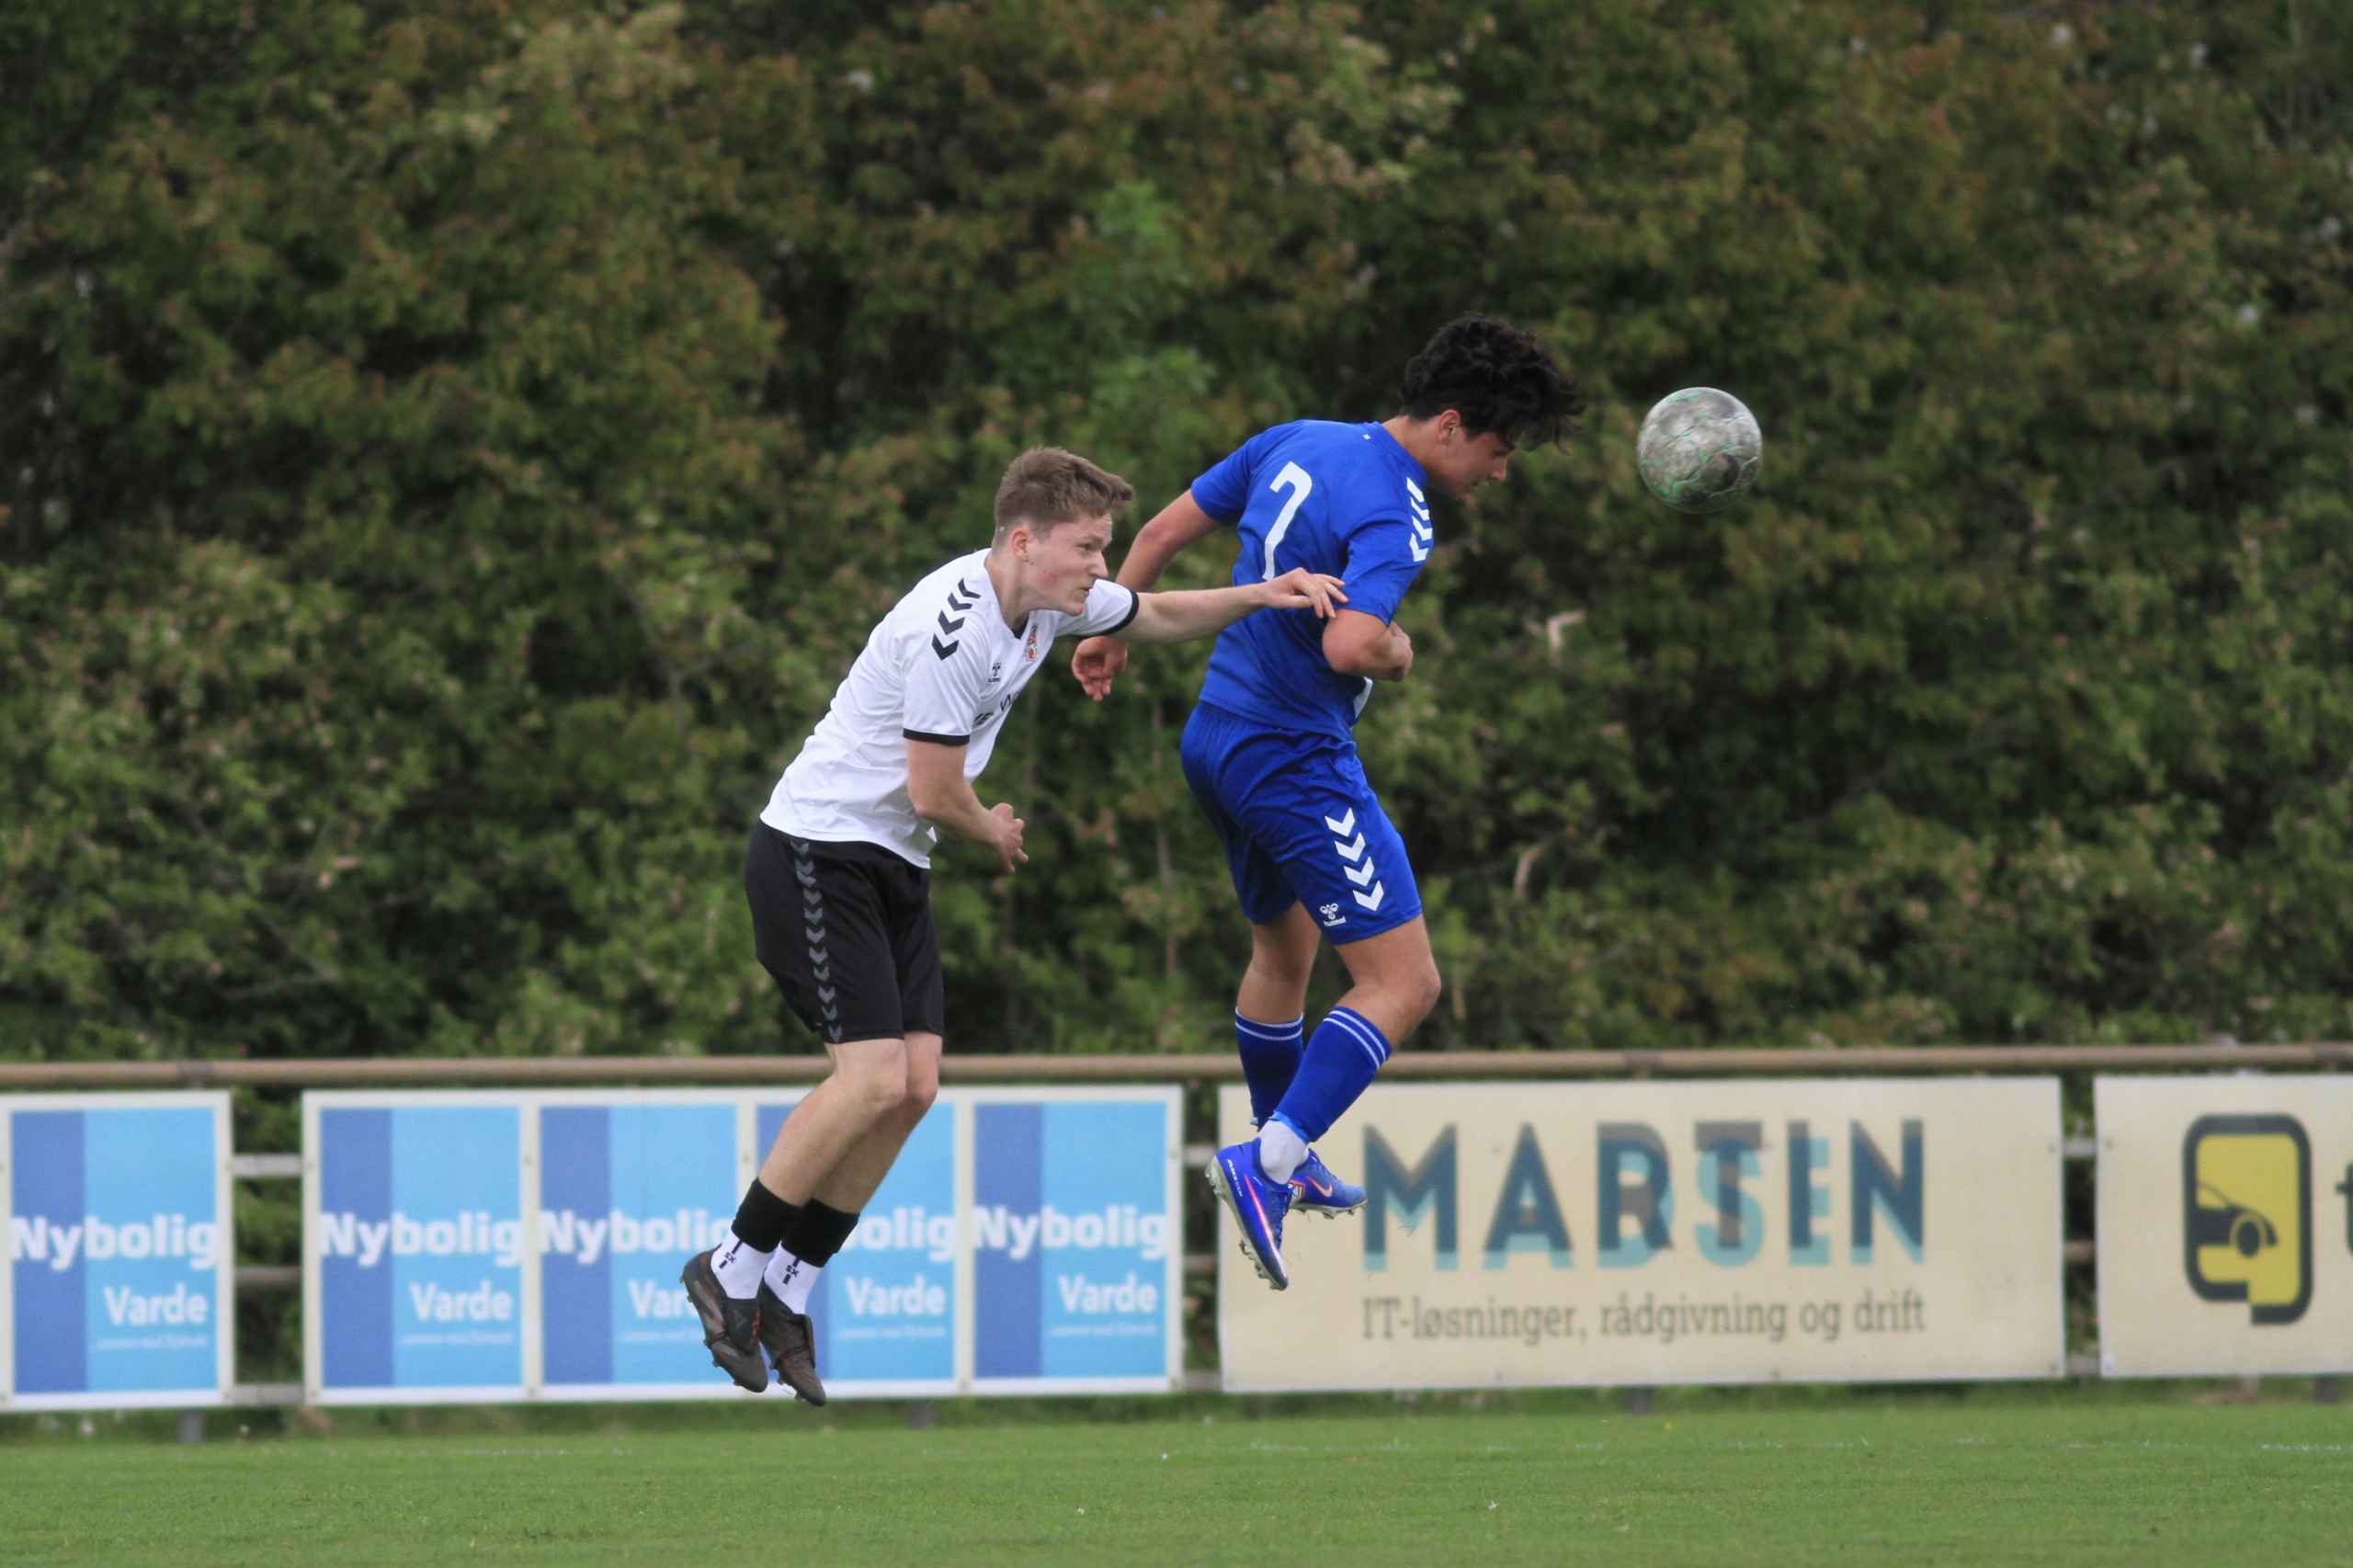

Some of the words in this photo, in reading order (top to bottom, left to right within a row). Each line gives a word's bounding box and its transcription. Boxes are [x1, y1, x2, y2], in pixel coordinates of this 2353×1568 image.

[1262, 460, 1313, 582] 7
[11, 1213, 219, 1270] Nybolig
[319, 1211, 524, 1267] Nybolig
[971, 1204, 1167, 1260] Nybolig
[104, 1282, 208, 1325] Varde
[409, 1278, 512, 1322] Varde
[628, 1278, 700, 1319] Var
[846, 1275, 946, 1316] Varde
[1059, 1272, 1157, 1313] Varde
[1363, 1293, 1587, 1347] IT-løsninger,
[1599, 1290, 1788, 1345] rådgivning
[1798, 1301, 1842, 1343] og
[1853, 1287, 1926, 1333] drift
